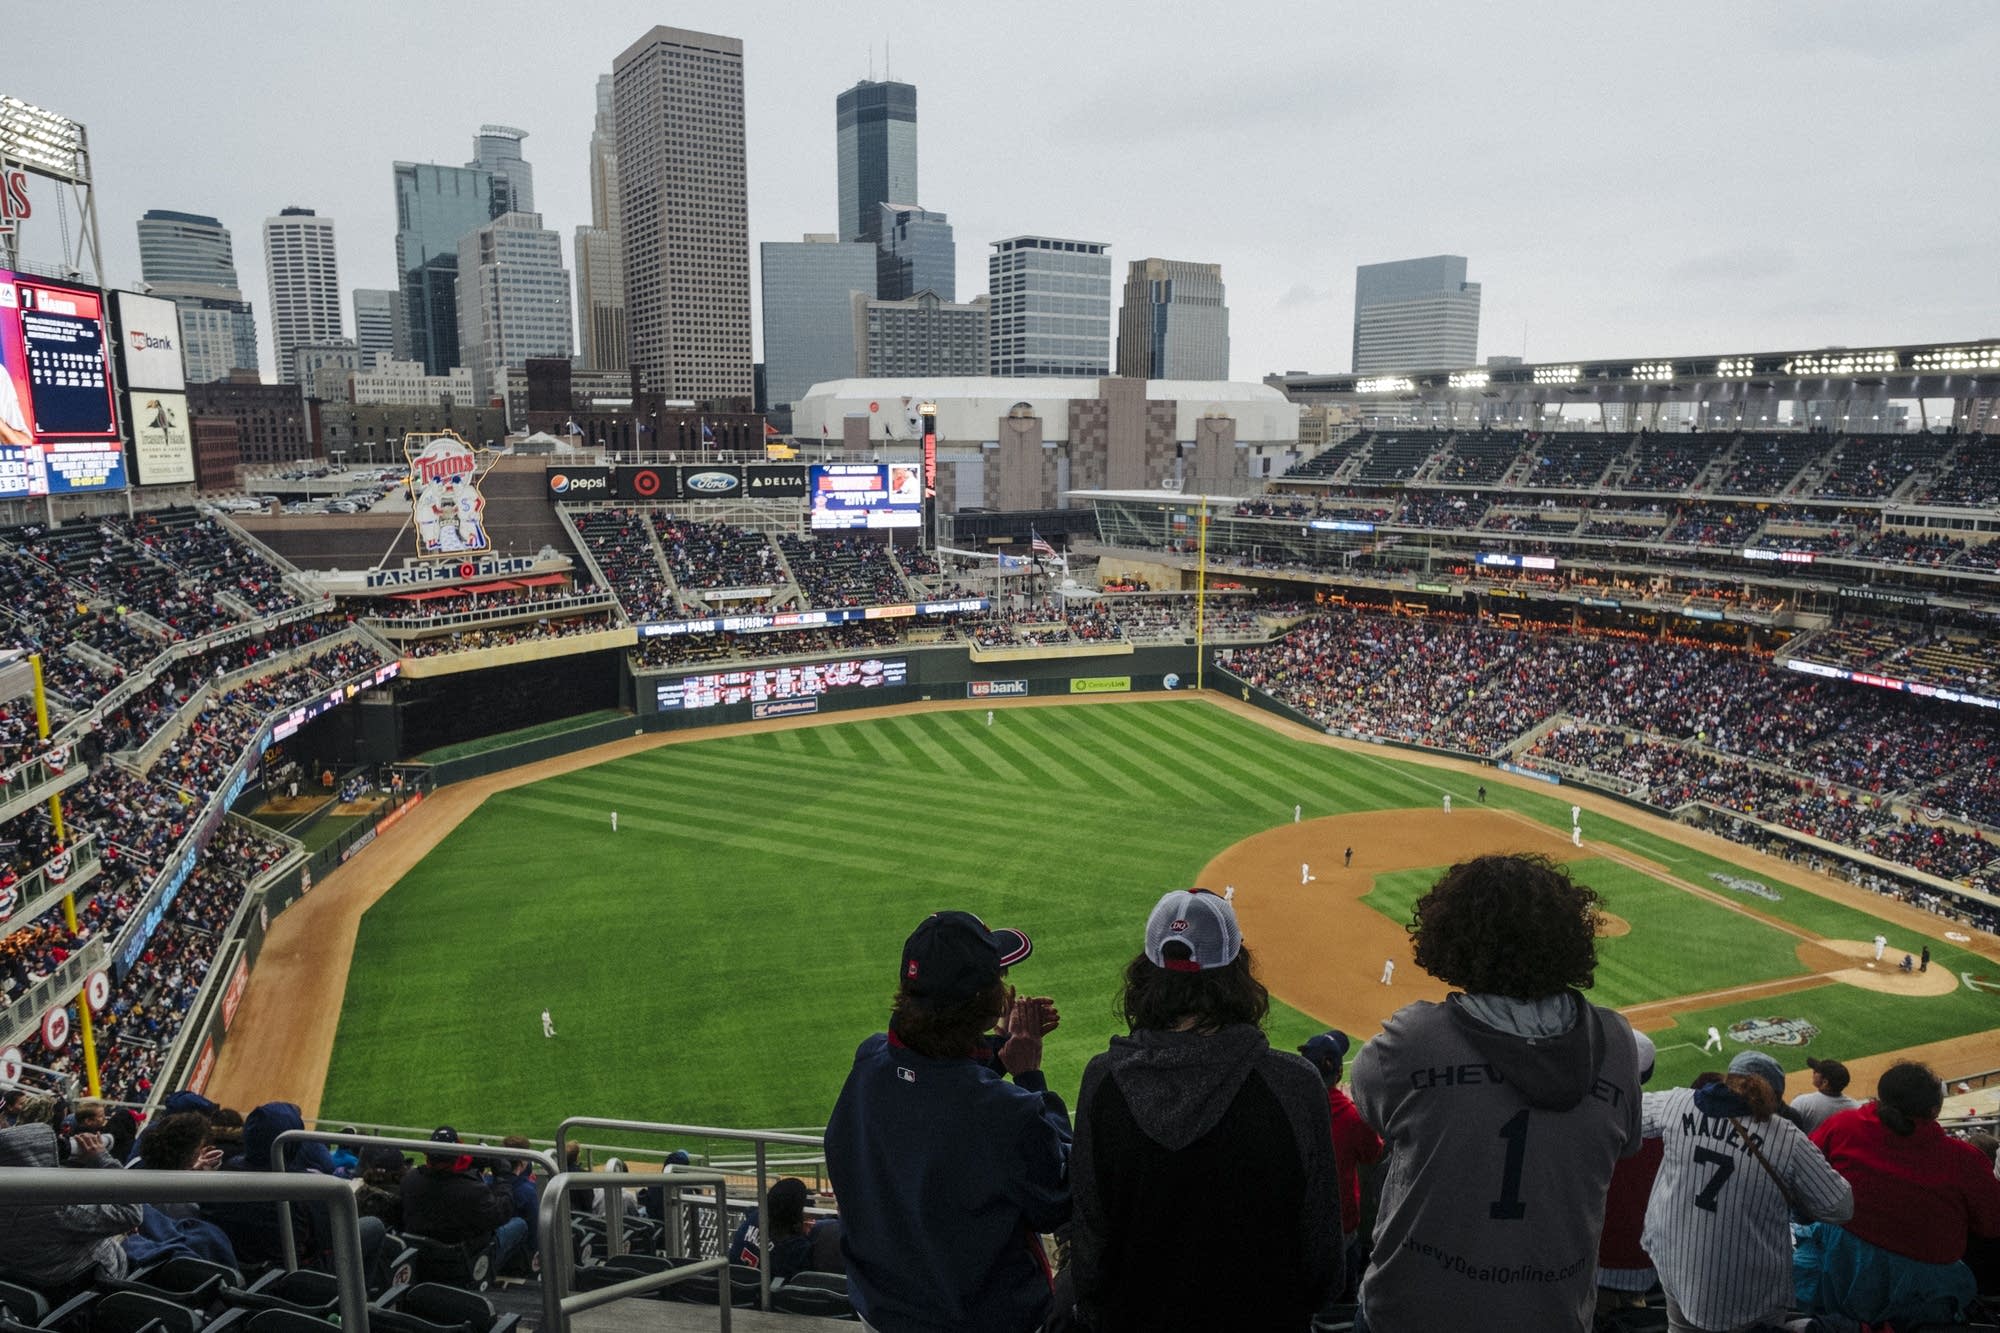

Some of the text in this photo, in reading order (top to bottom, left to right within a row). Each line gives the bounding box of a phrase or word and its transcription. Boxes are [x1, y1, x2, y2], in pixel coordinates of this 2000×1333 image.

[414, 452, 475, 486] Twins
[570, 477, 606, 490] pepsi
[696, 476, 730, 490] Ford
[765, 477, 802, 486] DELTA
[370, 559, 535, 588] TARGET FIELD
[1847, 590, 1874, 599] DELTA
[959, 600, 981, 611] PASS
[687, 620, 715, 632] PASS
[972, 681, 1025, 696] usbank
[1411, 1063, 1624, 1108] CHEVET
[1682, 1112, 1764, 1157] MAUER
[1489, 1109, 1530, 1220] 1
[1693, 1145, 1735, 1213] 7
